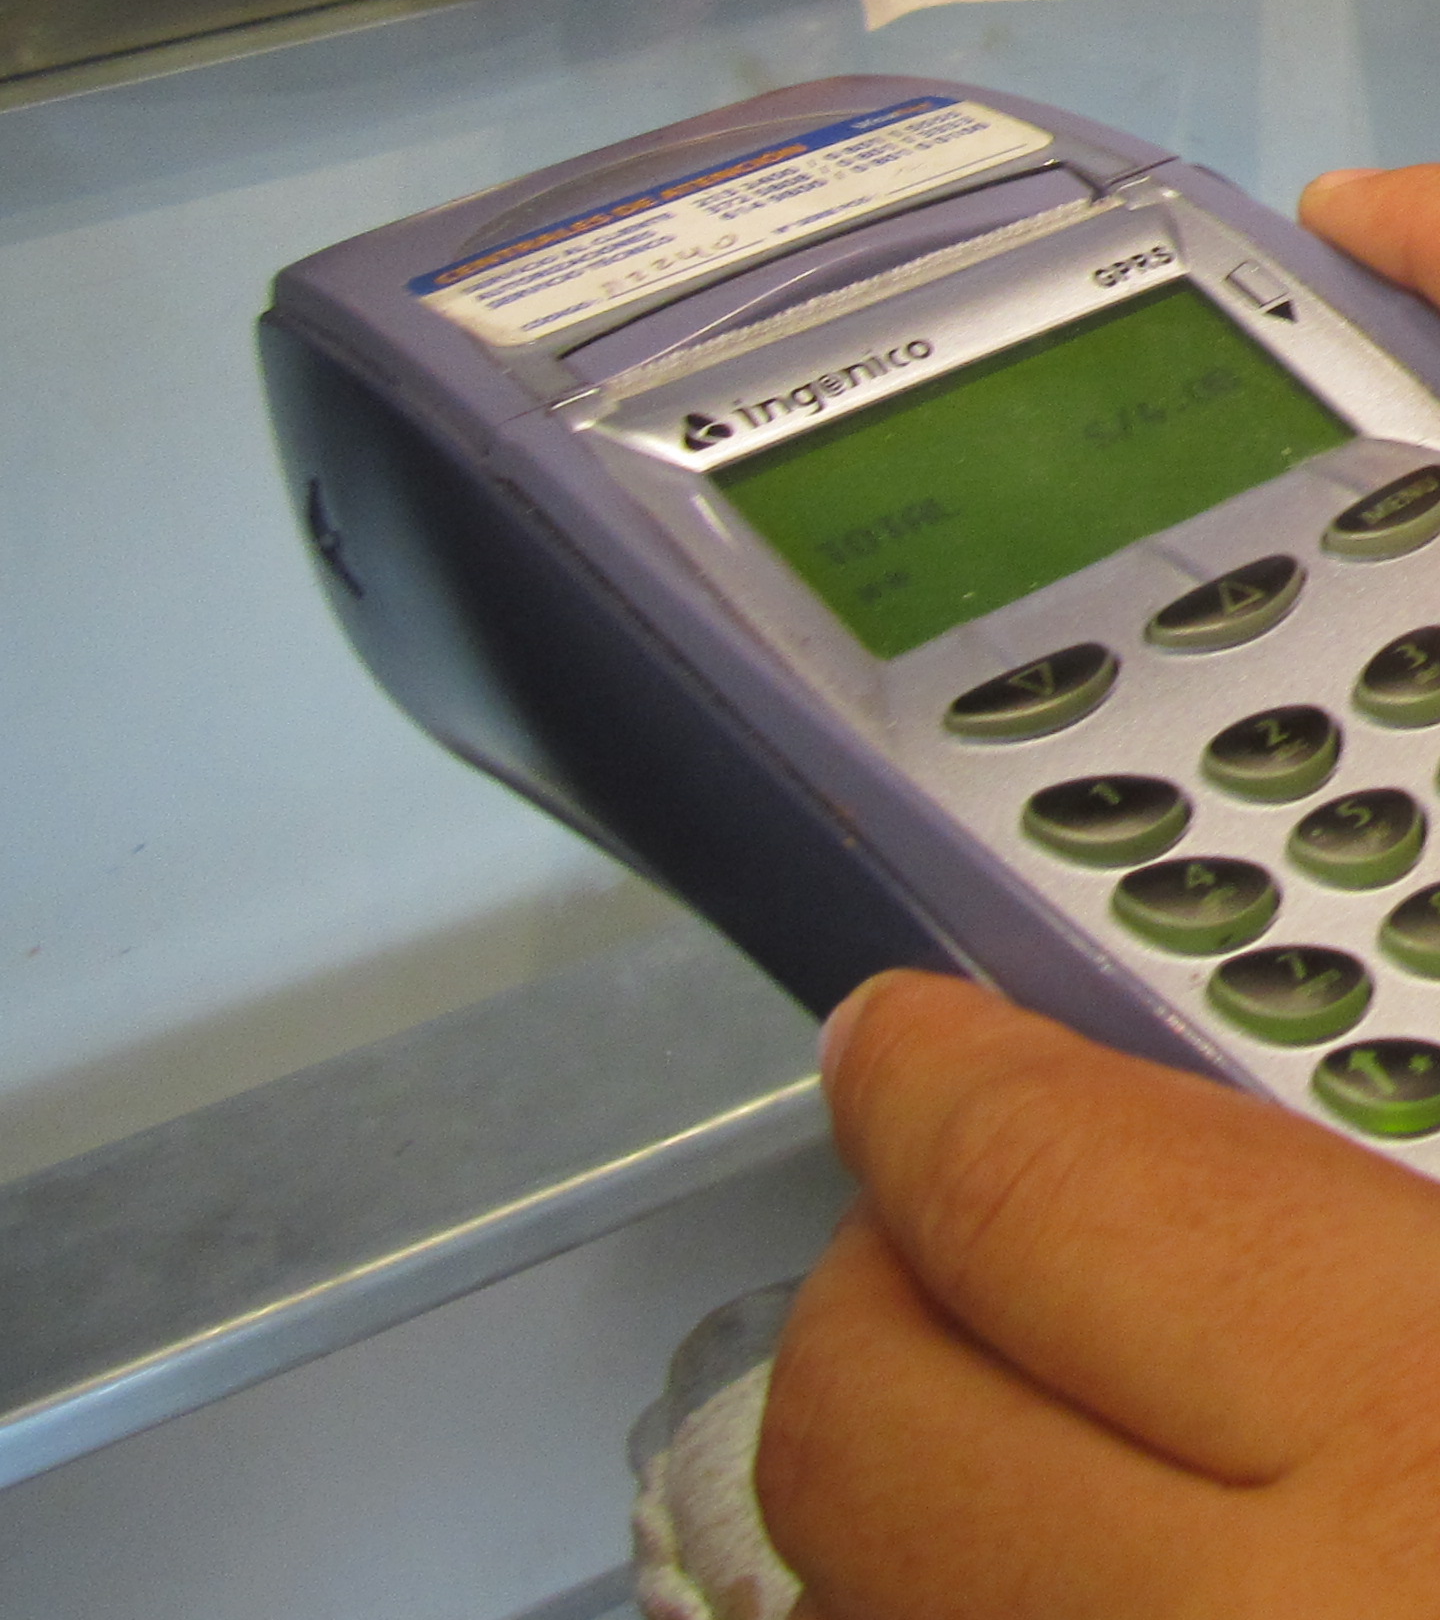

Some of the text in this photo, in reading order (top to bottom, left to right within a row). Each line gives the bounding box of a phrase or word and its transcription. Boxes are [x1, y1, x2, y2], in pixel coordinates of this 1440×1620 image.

[1092, 245, 1173, 289] GPRS
[732, 336, 934, 431] ingenico
[1396, 642, 1428, 670] 3
[1253, 718, 1290, 748] 2
[1088, 781, 1122, 806] 1
[1335, 798, 1373, 828] 5
[1184, 862, 1216, 890] 4
[1275, 950, 1308, 980] 7
